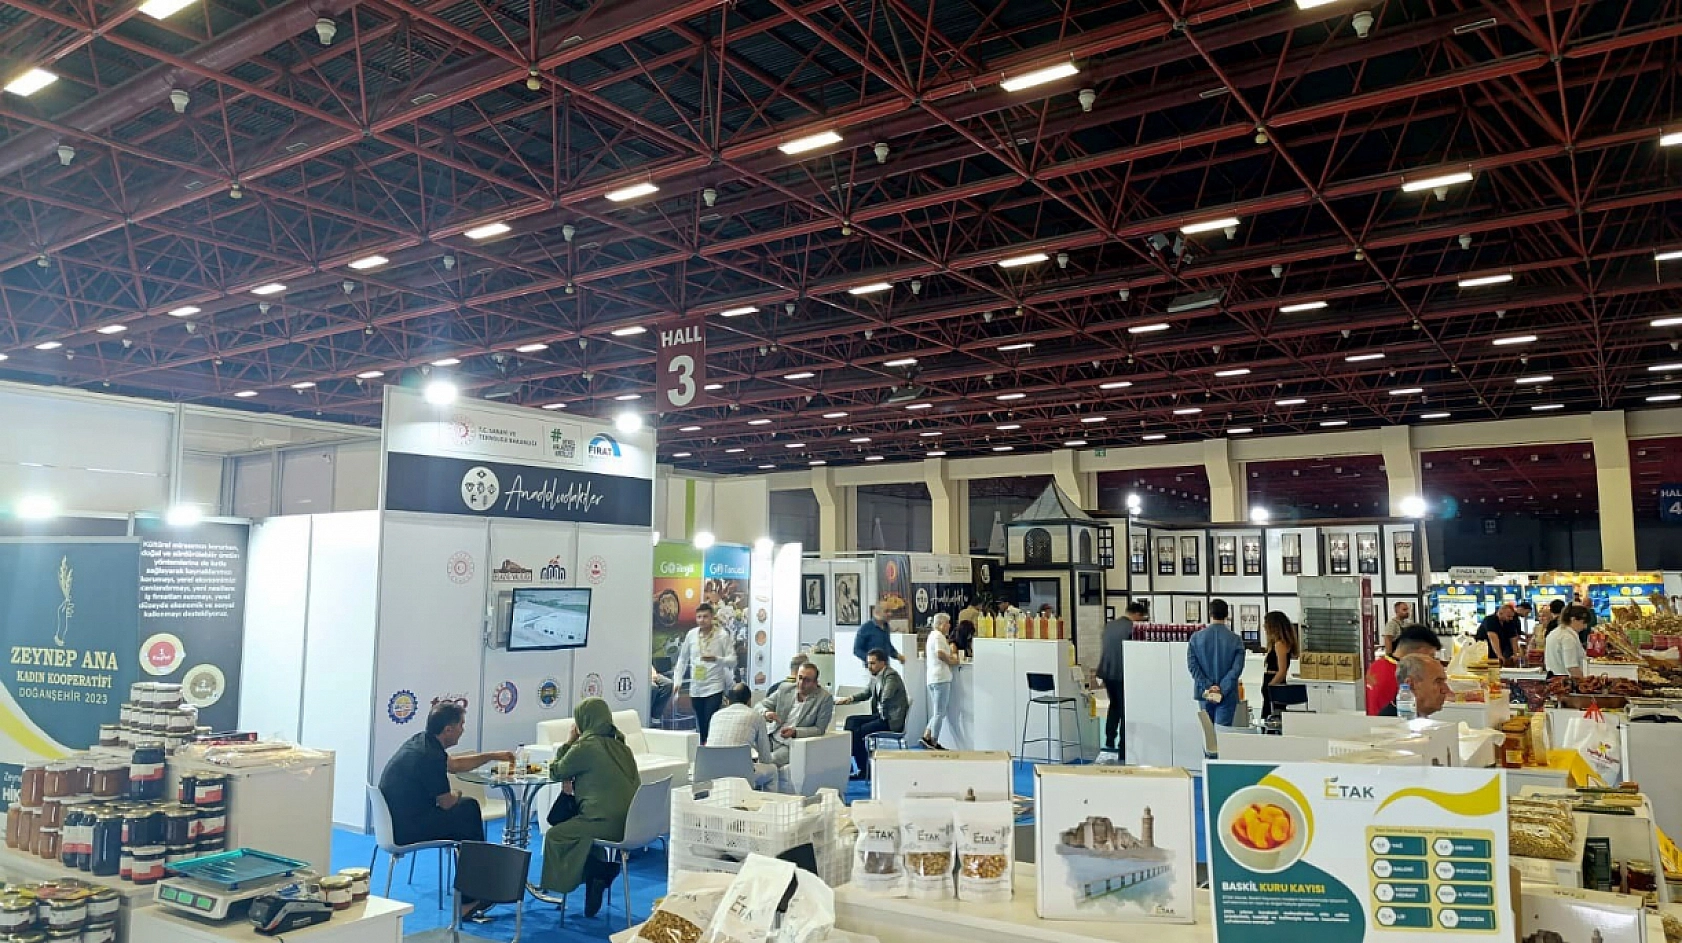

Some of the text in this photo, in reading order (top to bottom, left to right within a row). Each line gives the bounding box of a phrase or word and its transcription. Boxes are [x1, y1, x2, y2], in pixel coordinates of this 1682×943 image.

[661, 326, 702, 348] HALL
[667, 355, 696, 407] 3
[588, 446, 612, 456] FIRAT
[1669, 502, 1682, 515] 4
[141, 549, 162, 557] doğal
[10, 646, 118, 671] ZEYNEP ANA
[16, 670, 113, 688] KADIN KOOPERATİFİ
[19, 686, 108, 705] DOĞANŞEHİR 2023
[1323, 776, 1375, 798] ETAK
[867, 826, 894, 841] ETAK
[918, 830, 940, 841] ETAK
[973, 832, 996, 844] ETAK
[1221, 880, 1326, 894] BASKİL KURU KAYISI
